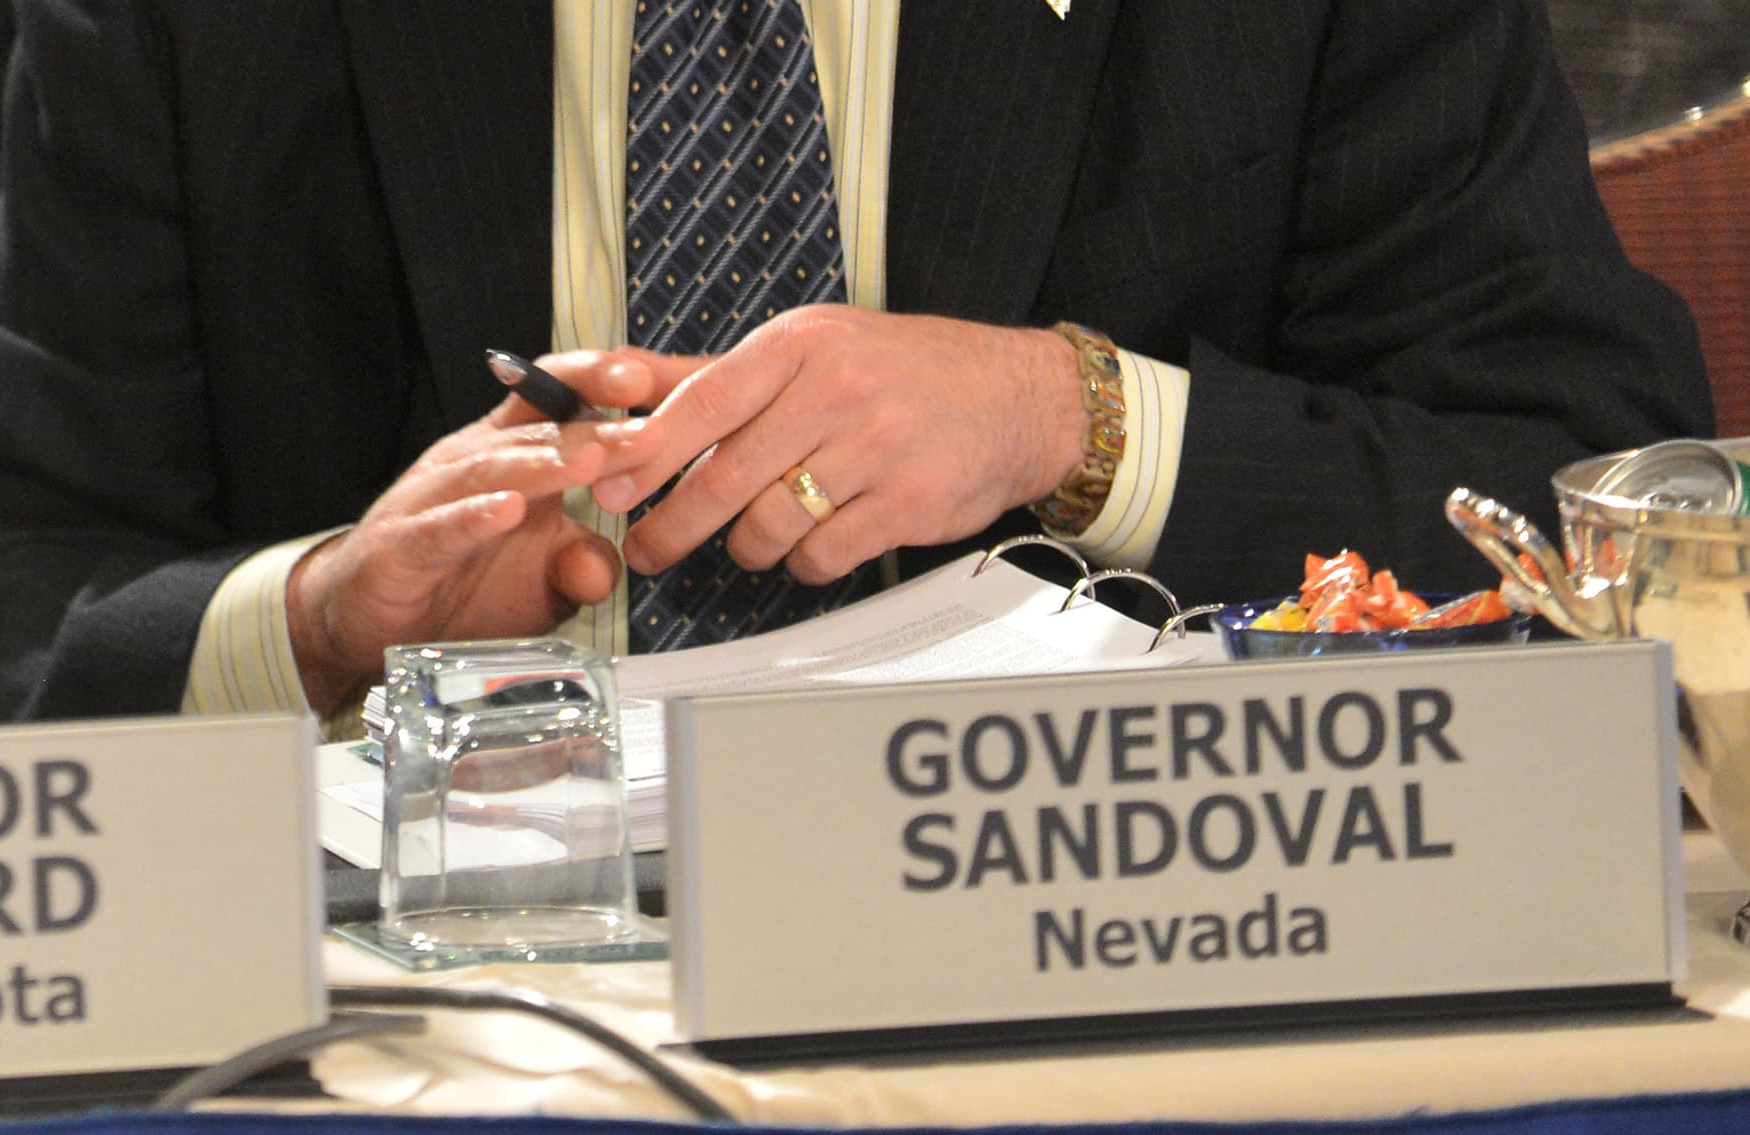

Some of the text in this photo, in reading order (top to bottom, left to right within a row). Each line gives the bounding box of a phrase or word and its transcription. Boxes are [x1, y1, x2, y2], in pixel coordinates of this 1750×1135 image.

[884, 686, 1463, 798] GOVERNOR
[901, 781, 1456, 892] SANDOVAL
[1033, 892, 1329, 973] Nevada
